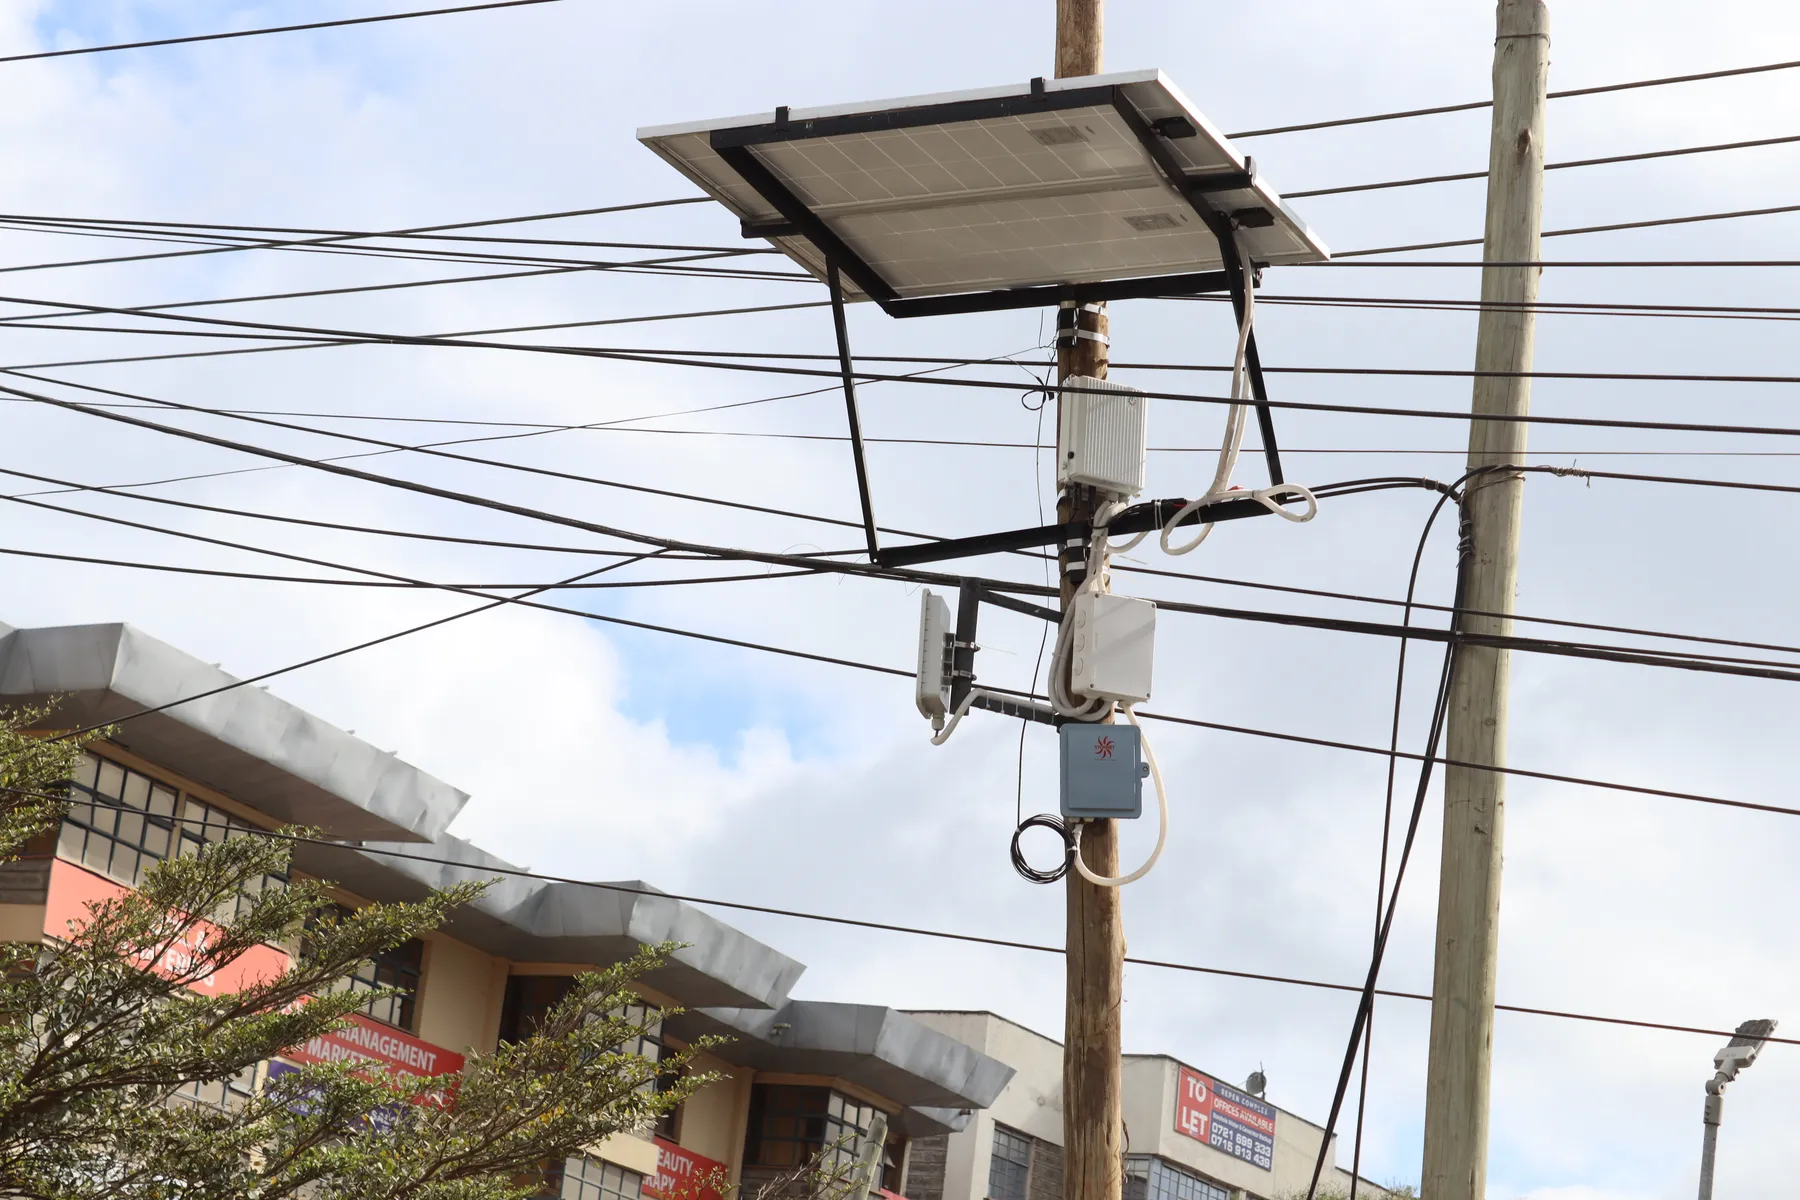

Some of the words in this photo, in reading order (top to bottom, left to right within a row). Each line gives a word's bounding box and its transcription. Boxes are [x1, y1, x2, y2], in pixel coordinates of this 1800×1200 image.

[336, 1026, 437, 1072] MANAGEMENT
[1187, 1076, 1207, 1103] TO
[1241, 1098, 1269, 1116] COMPLEX
[1181, 1106, 1208, 1136] LET
[1213, 1098, 1240, 1118] OFFICES
[1239, 1111, 1273, 1133] AVAILABLE
[1211, 1122, 1234, 1140] 0721
[1235, 1133, 1253, 1149] 699
[1254, 1141, 1271, 1157] 333
[1211, 1134, 1233, 1152] 0715
[1234, 1145, 1252, 1161] 913
[1253, 1153, 1271, 1169] 439
